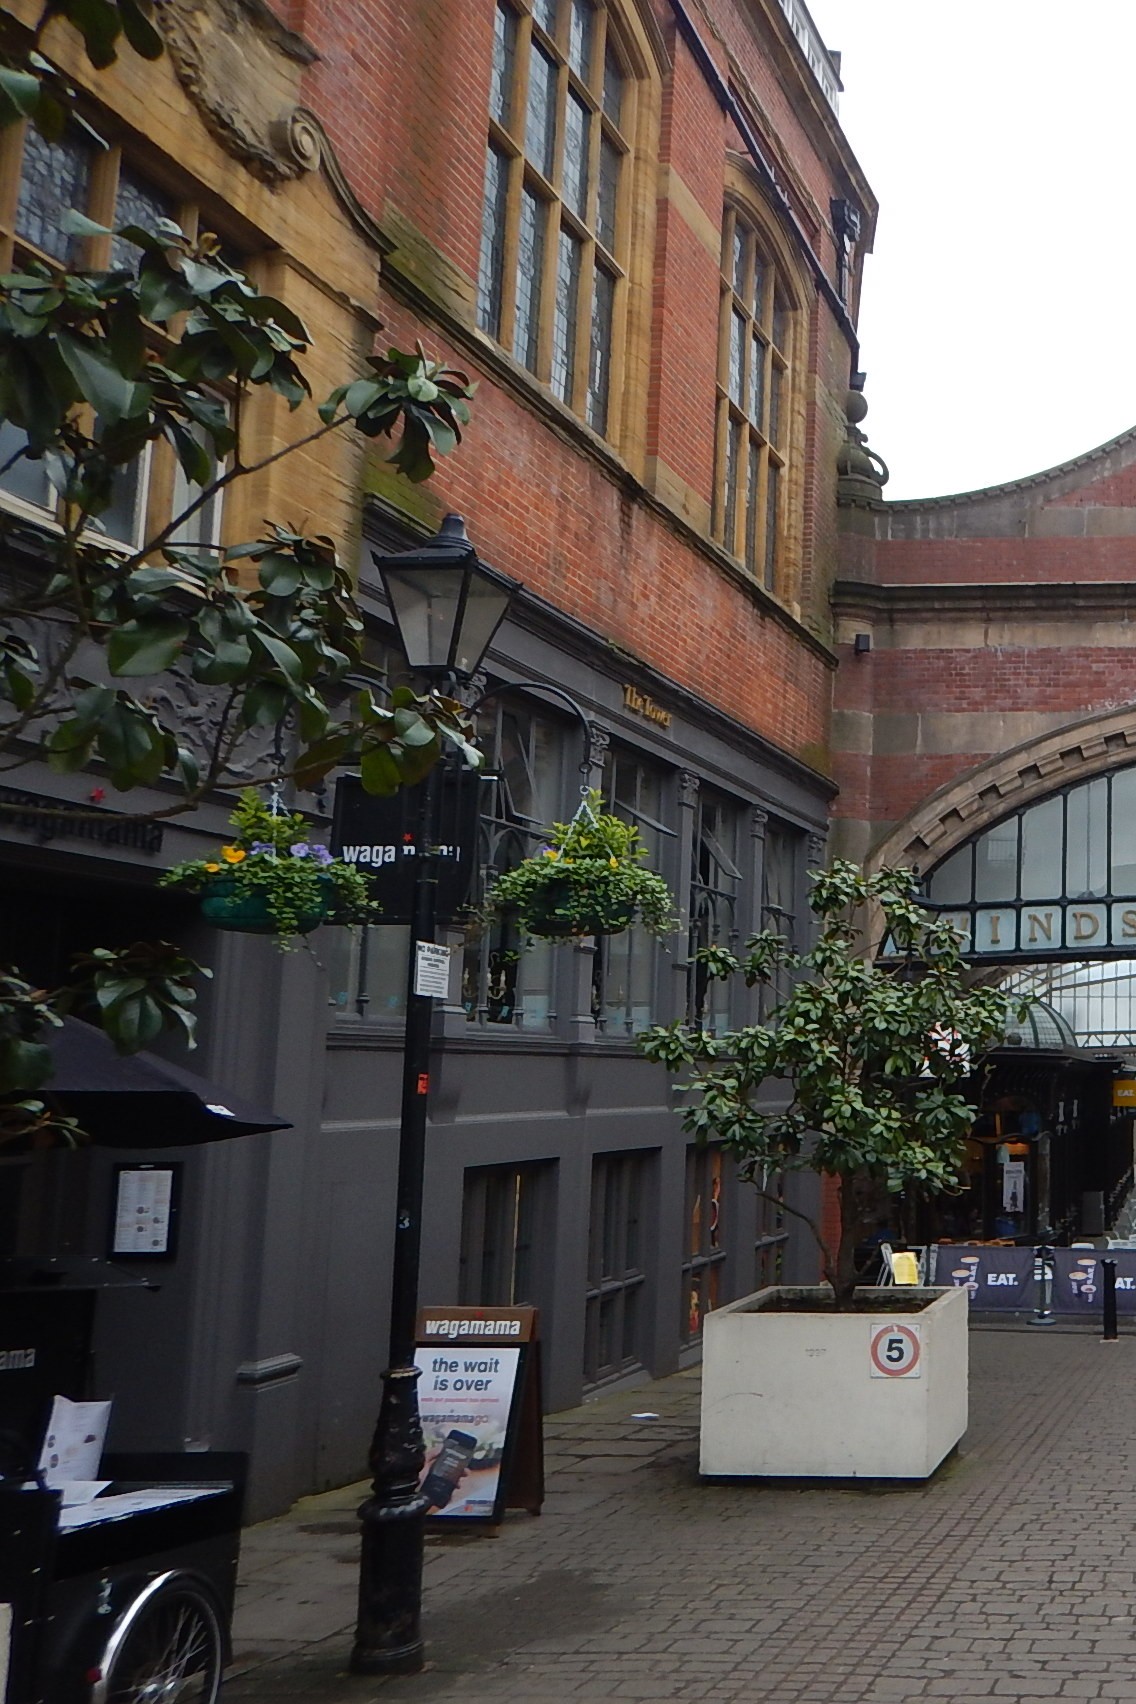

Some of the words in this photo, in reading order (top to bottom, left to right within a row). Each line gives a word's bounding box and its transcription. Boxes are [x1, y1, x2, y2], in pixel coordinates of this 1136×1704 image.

[987, 1273, 1019, 1286] EAT.
[425, 1319, 521, 1339] wagamama
[885, 1338, 905, 1363] 5
[431, 1357, 459, 1373] the
[463, 1357, 500, 1373] wait
[433, 1375, 449, 1391] is
[453, 1378, 492, 1392] over
